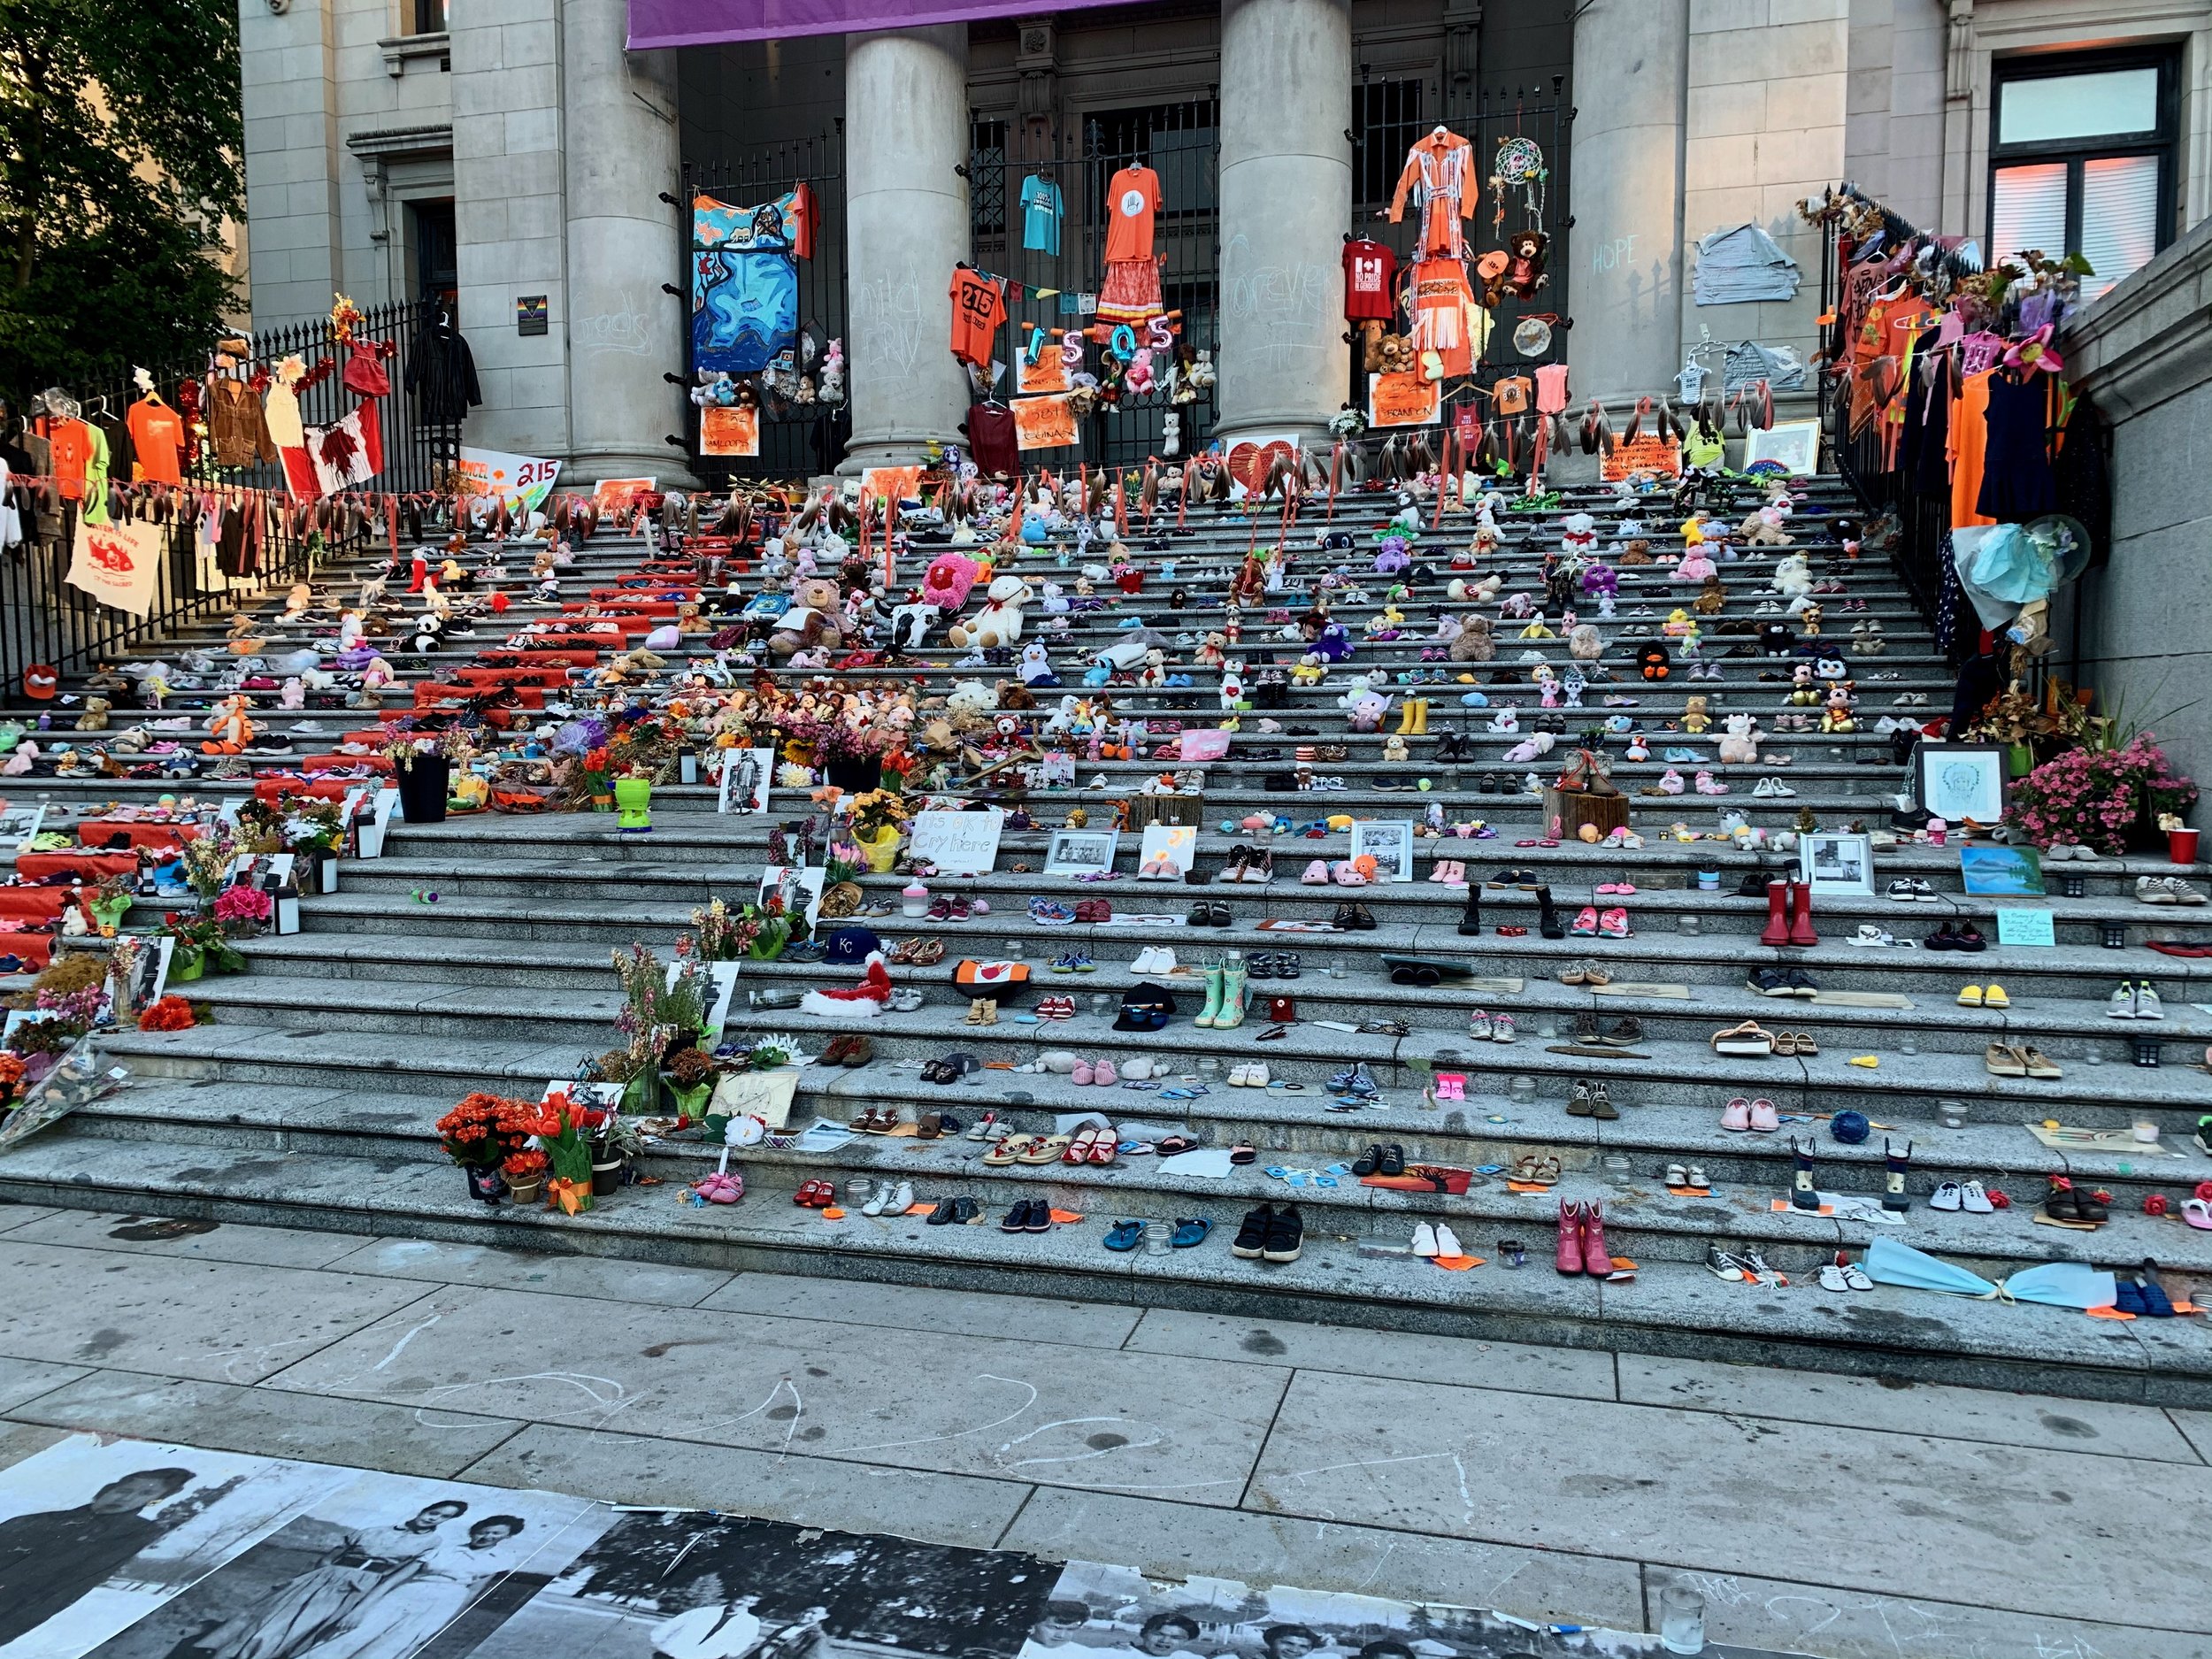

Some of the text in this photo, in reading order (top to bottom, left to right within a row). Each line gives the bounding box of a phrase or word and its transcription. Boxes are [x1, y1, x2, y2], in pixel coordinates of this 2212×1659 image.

[1594, 234, 1640, 276] HOPE
[1356, 273, 1381, 281] NO PRIDE
[963, 284, 992, 314] 215
[517, 460, 557, 488] 215
[124, 534, 140, 549] LIFE
[913, 832, 991, 854] Cry here
[839, 937, 853, 954] KC
